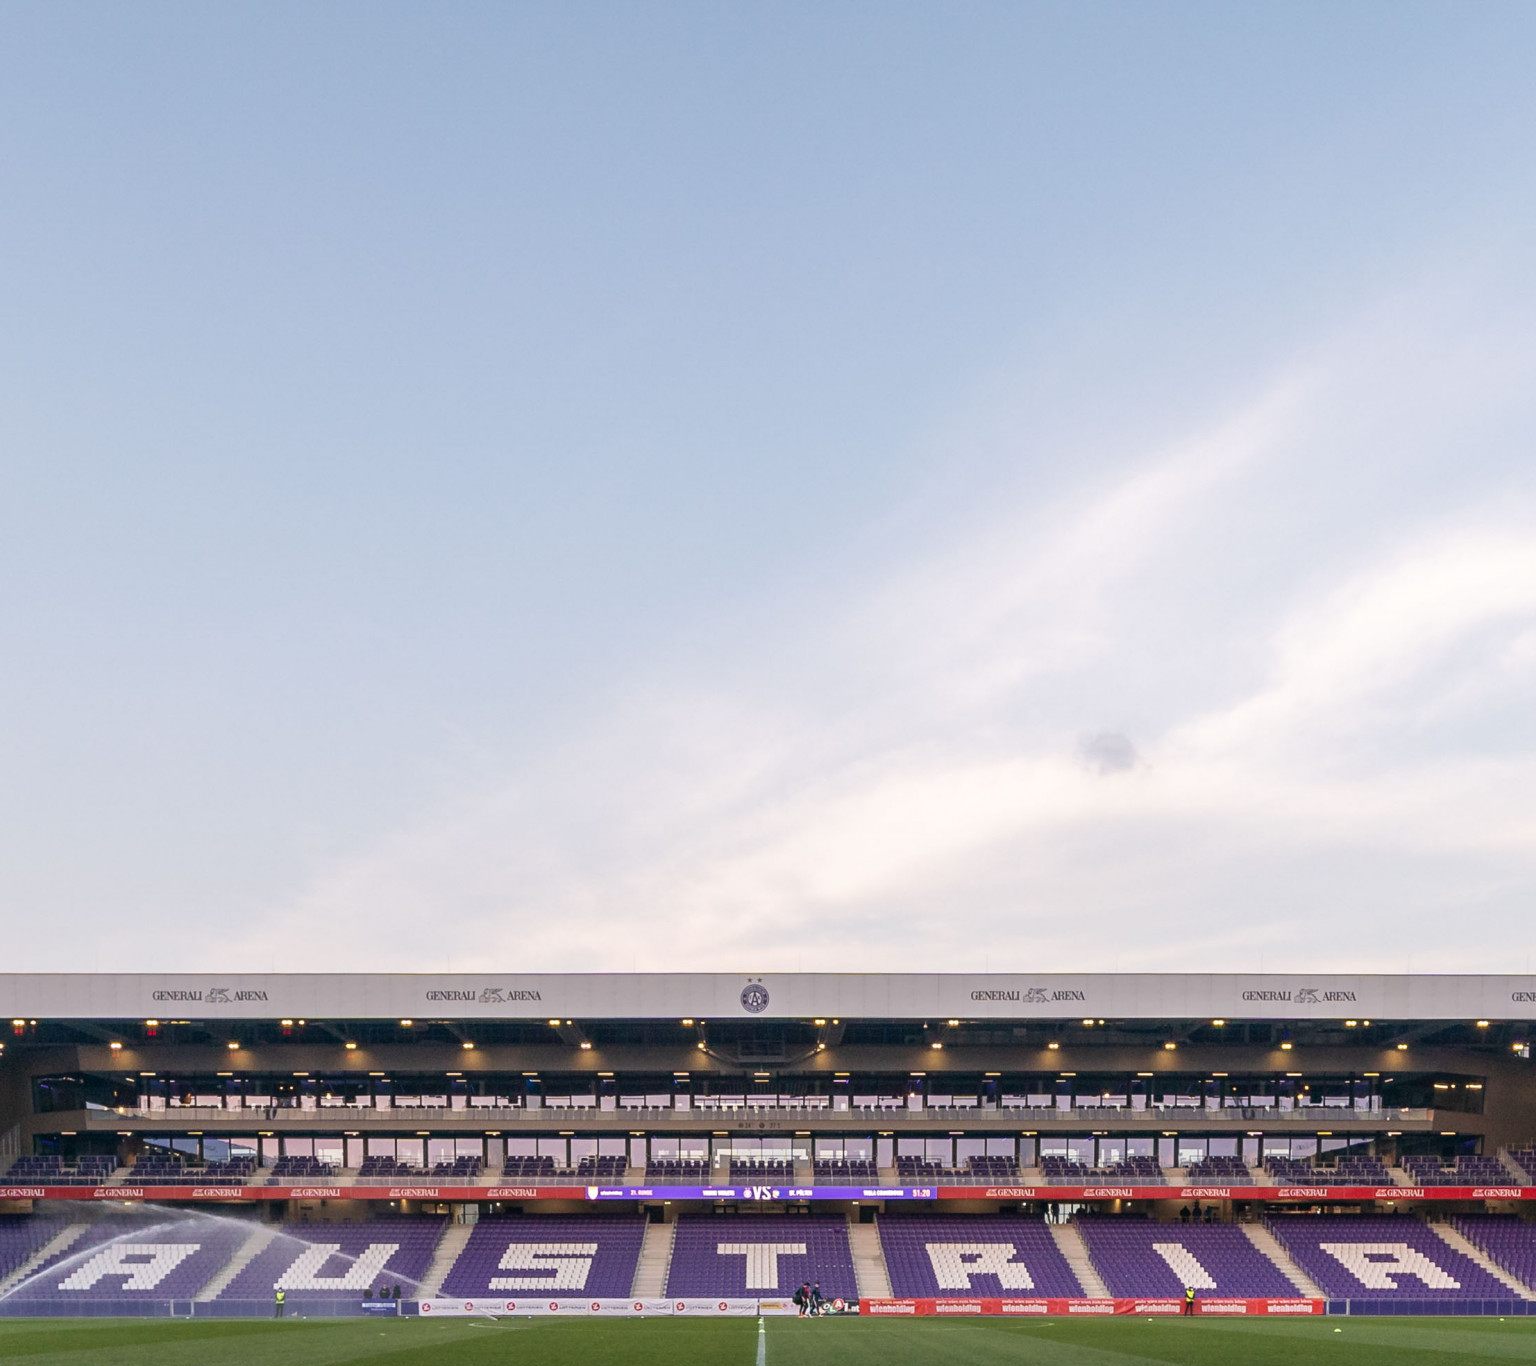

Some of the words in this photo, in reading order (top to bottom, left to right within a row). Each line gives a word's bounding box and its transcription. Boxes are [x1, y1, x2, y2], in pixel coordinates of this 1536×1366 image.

[153, 990, 202, 1001] GENERALI
[234, 990, 268, 1001] ARENA
[426, 990, 475, 1001] GENERALI
[507, 990, 541, 1001] ARENA
[971, 990, 1019, 1001] GENERALI
[1051, 990, 1085, 1001] ARENA
[1243, 990, 1291, 1001] GENERALI
[1322, 990, 1356, 1001] ARENA
[6, 1188, 44, 1197] GENERALI
[105, 1188, 143, 1197] GENERALI
[203, 1188, 241, 1197] GENERALI
[302, 1188, 340, 1197] GENERALI
[400, 1188, 438, 1197] GENERALI
[498, 1188, 536, 1197] GENERALI
[753, 1186, 772, 1200] VS
[997, 1188, 1035, 1197] GENERALI
[1094, 1188, 1132, 1197] GENERALI
[1192, 1188, 1230, 1197] GENERALI
[1289, 1188, 1327, 1197] GENERALI
[1386, 1188, 1424, 1197] GENERALI
[1483, 1188, 1521, 1197] GENERALI
